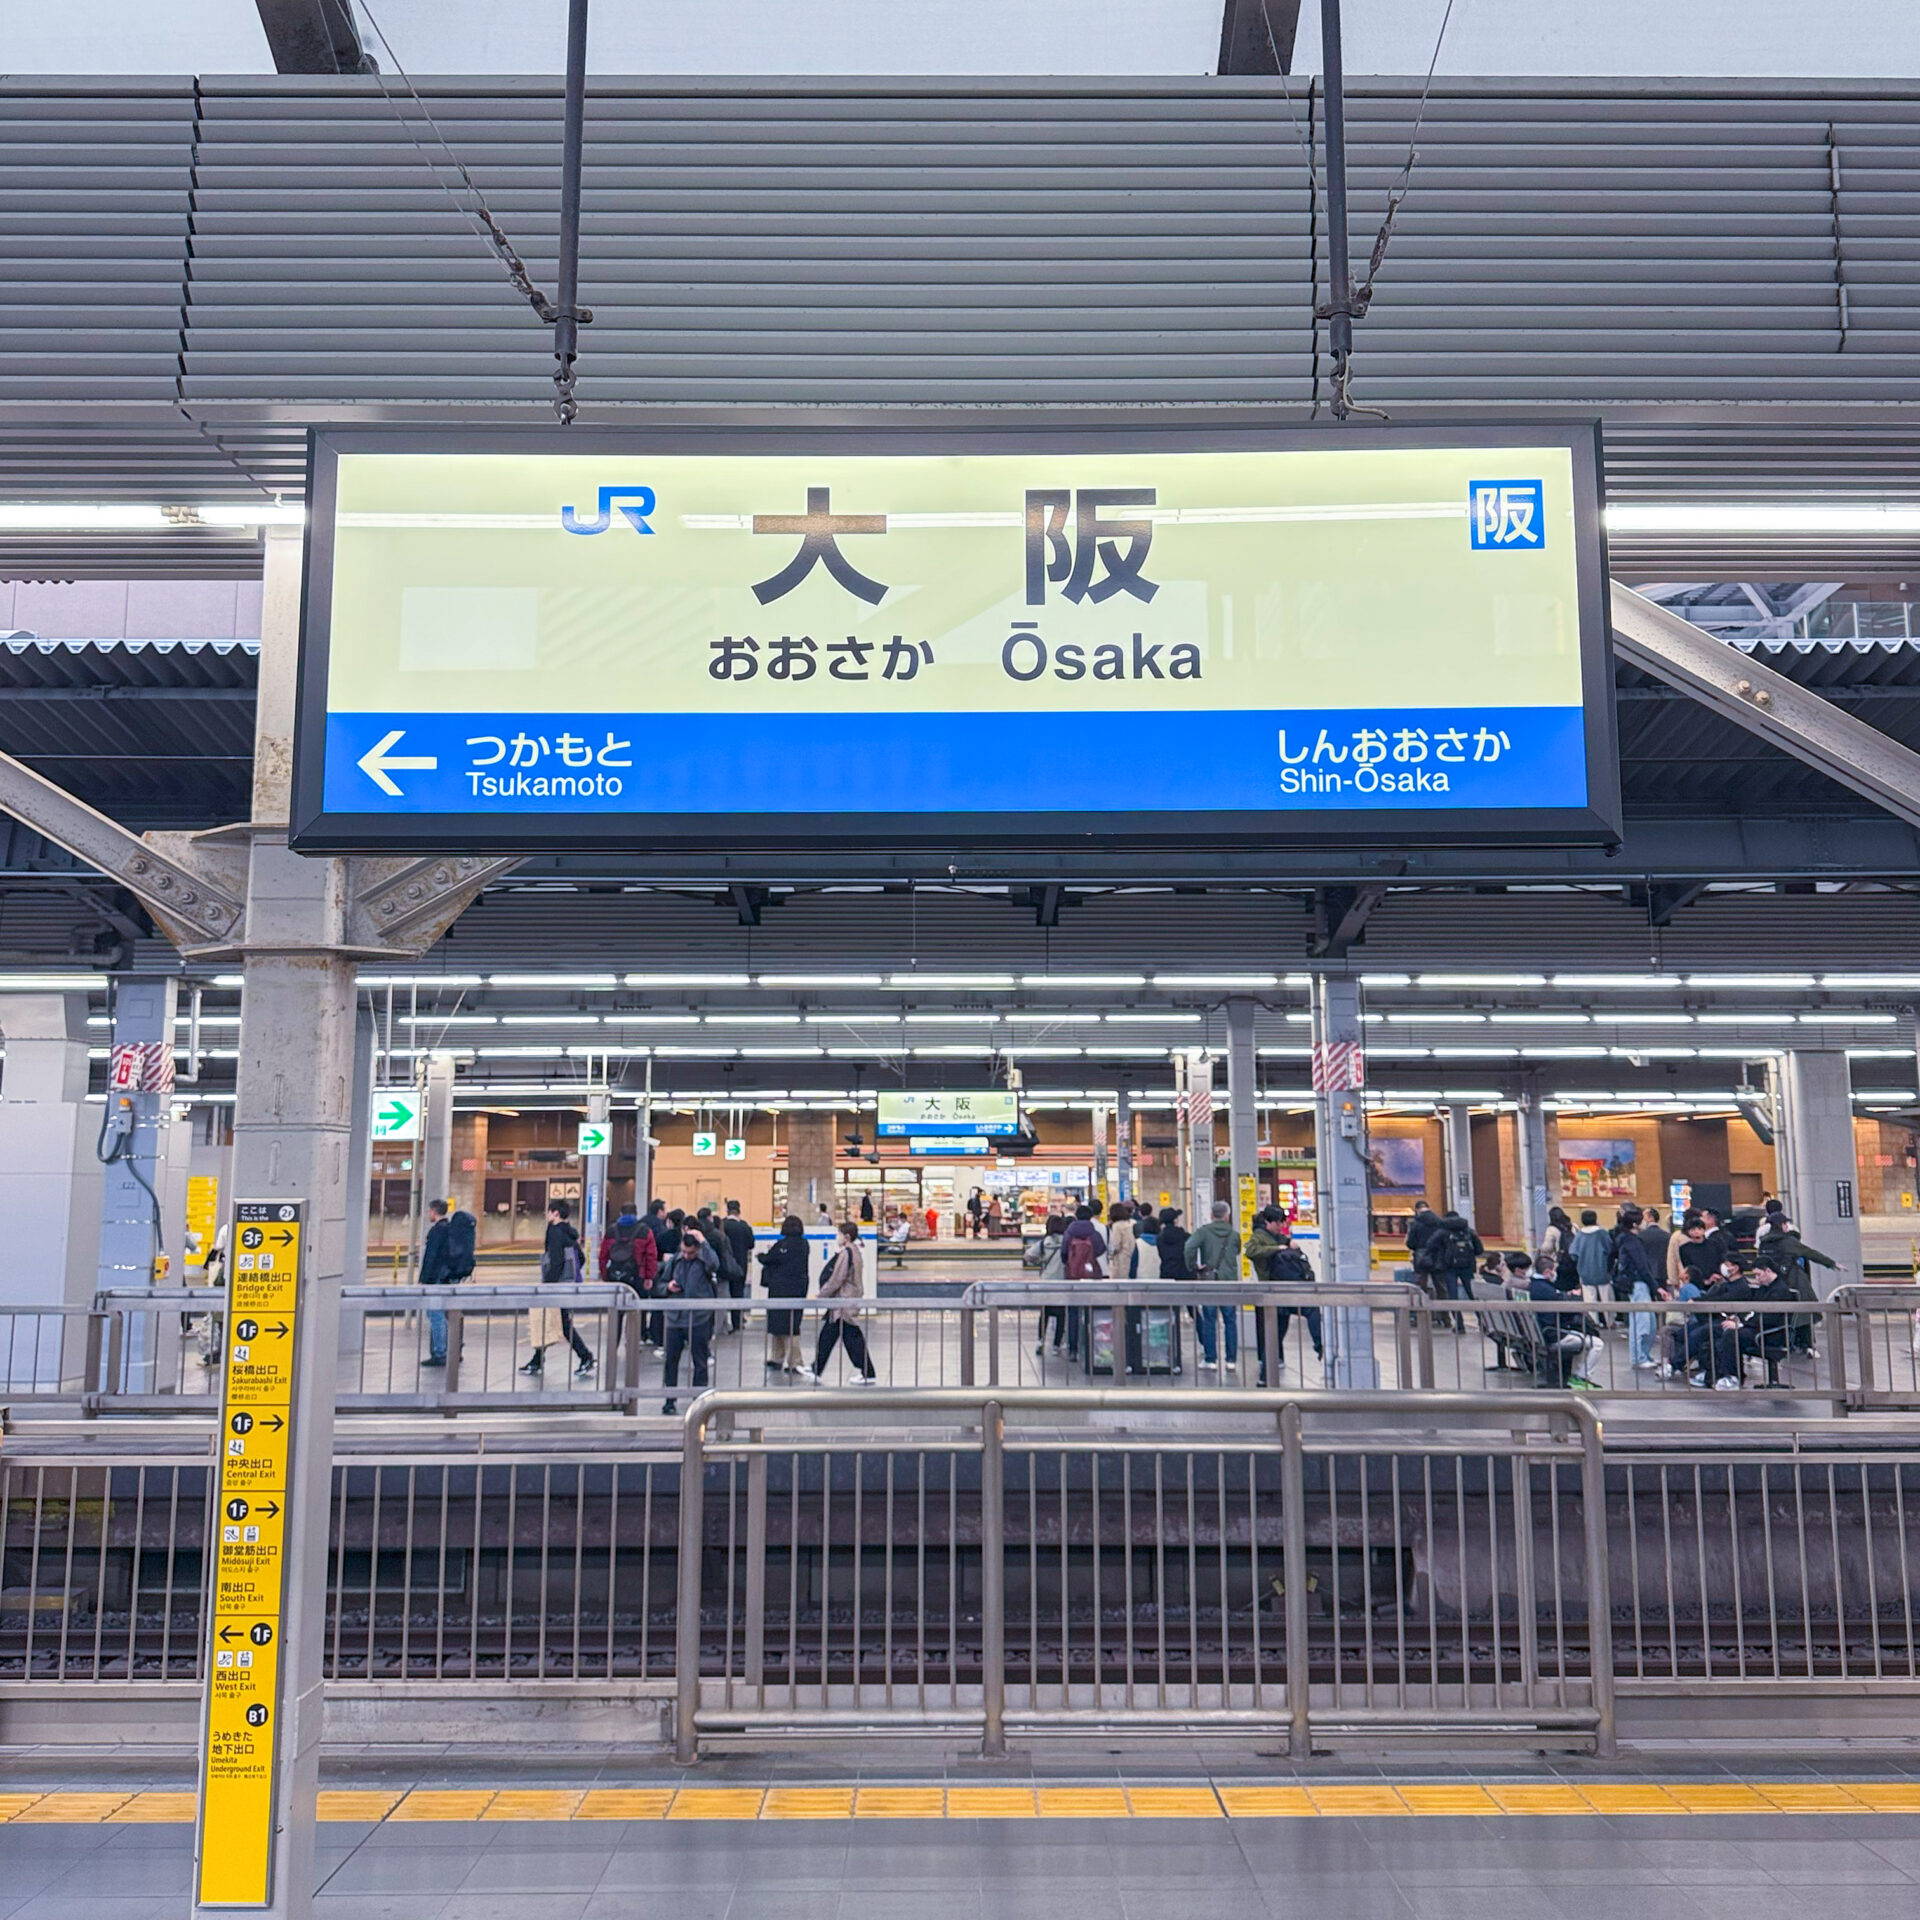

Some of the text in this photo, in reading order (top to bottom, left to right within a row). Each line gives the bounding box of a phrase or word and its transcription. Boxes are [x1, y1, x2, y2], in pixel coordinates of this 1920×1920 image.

[561, 486, 657, 536] JR
[1475, 485, 1540, 546] 阪
[1001, 620, 1203, 682] Ōsaka
[708, 634, 936, 682] おおさか
[465, 730, 634, 768] つかもと
[1277, 726, 1512, 765] しんおおさか
[466, 770, 625, 798] Tsukamoto
[1279, 762, 1450, 794] Shin-Ōsaka
[241, 1206, 268, 1215] ここは
[281, 1208, 294, 1218] 2F
[244, 1231, 262, 1246] 3F
[236, 1284, 283, 1294] Bridge Exit
[239, 1323, 257, 1338] 1F
[232, 1365, 278, 1375] 桜橋出口
[231, 1376, 287, 1384] Sakurabashi Exit
[234, 1416, 252, 1431] 1F
[227, 1458, 273, 1469] 中央出口
[226, 1470, 276, 1479] Central Exit
[229, 1502, 248, 1517] 1F
[222, 1545, 278, 1556] 御堂筋出口
[256, 1557, 271, 1566] Exit
[220, 1582, 256, 1593] 南出口
[219, 1594, 265, 1603] South Exit
[253, 1626, 271, 1642] 1F
[215, 1670, 251, 1682] 西出口
[215, 1682, 257, 1691] West Exit
[248, 1707, 266, 1723] B1
[212, 1731, 253, 1743] うめきた
[211, 1743, 255, 1755] 地下出口
[210, 1756, 238, 1764] Umekita
[210, 1764, 266, 1774] Underground Exit
